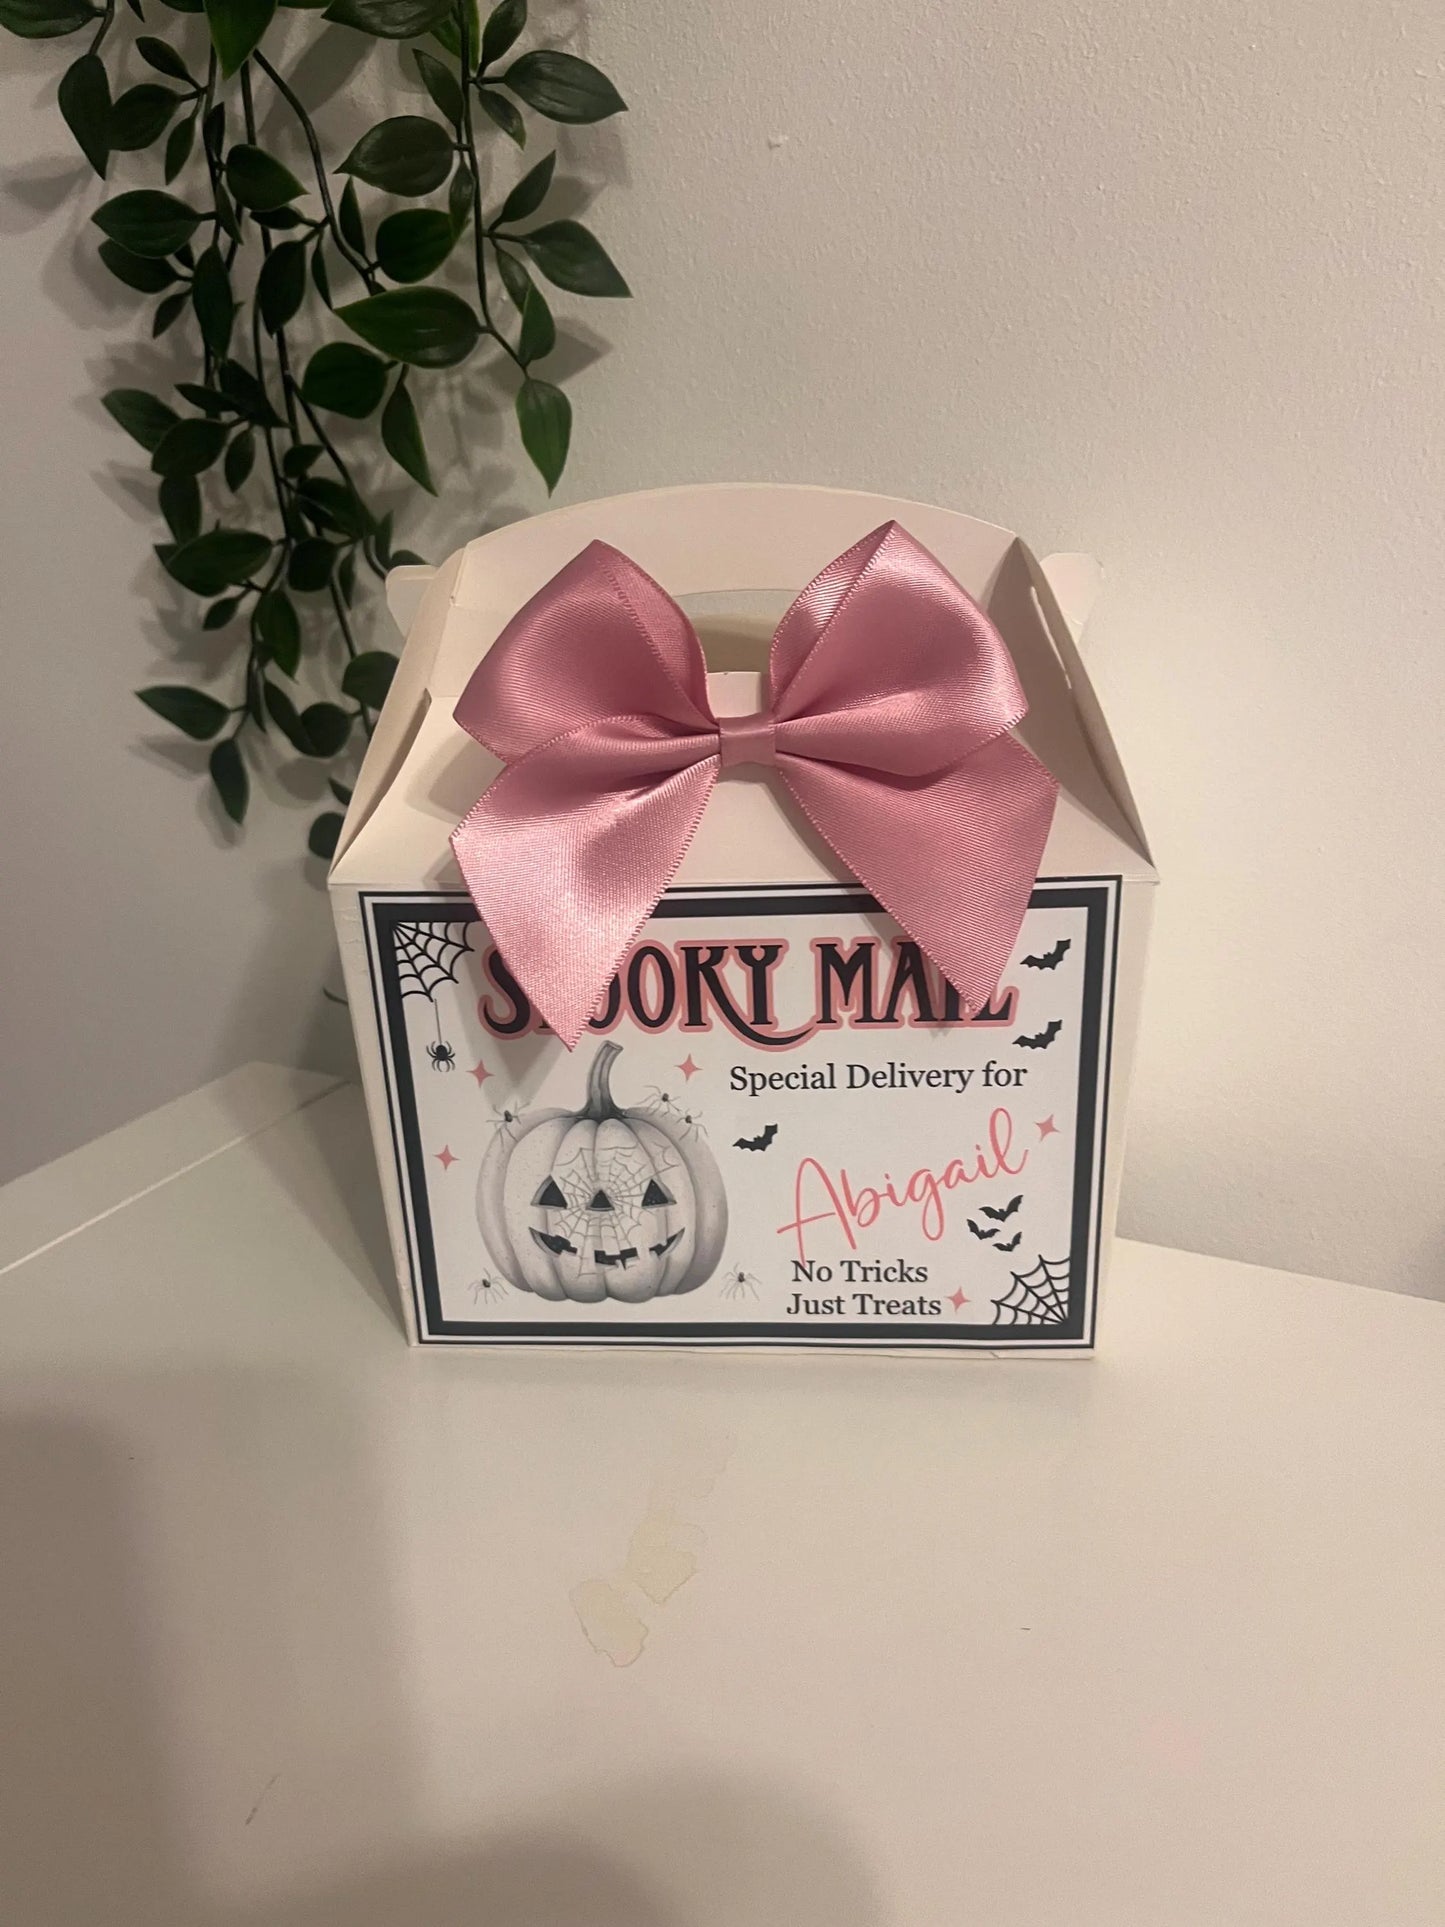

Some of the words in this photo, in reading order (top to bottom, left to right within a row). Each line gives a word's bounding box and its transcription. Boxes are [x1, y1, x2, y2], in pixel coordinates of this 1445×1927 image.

[729, 1063, 836, 1097] Special
[846, 1062, 975, 1093] Delivery
[982, 1061, 1028, 1089] for
[777, 1107, 1029, 1267] Abigail
[791, 1260, 832, 1283] No
[840, 1260, 928, 1283] Tricks
[786, 1293, 845, 1315] Just
[853, 1293, 942, 1316] Treats
